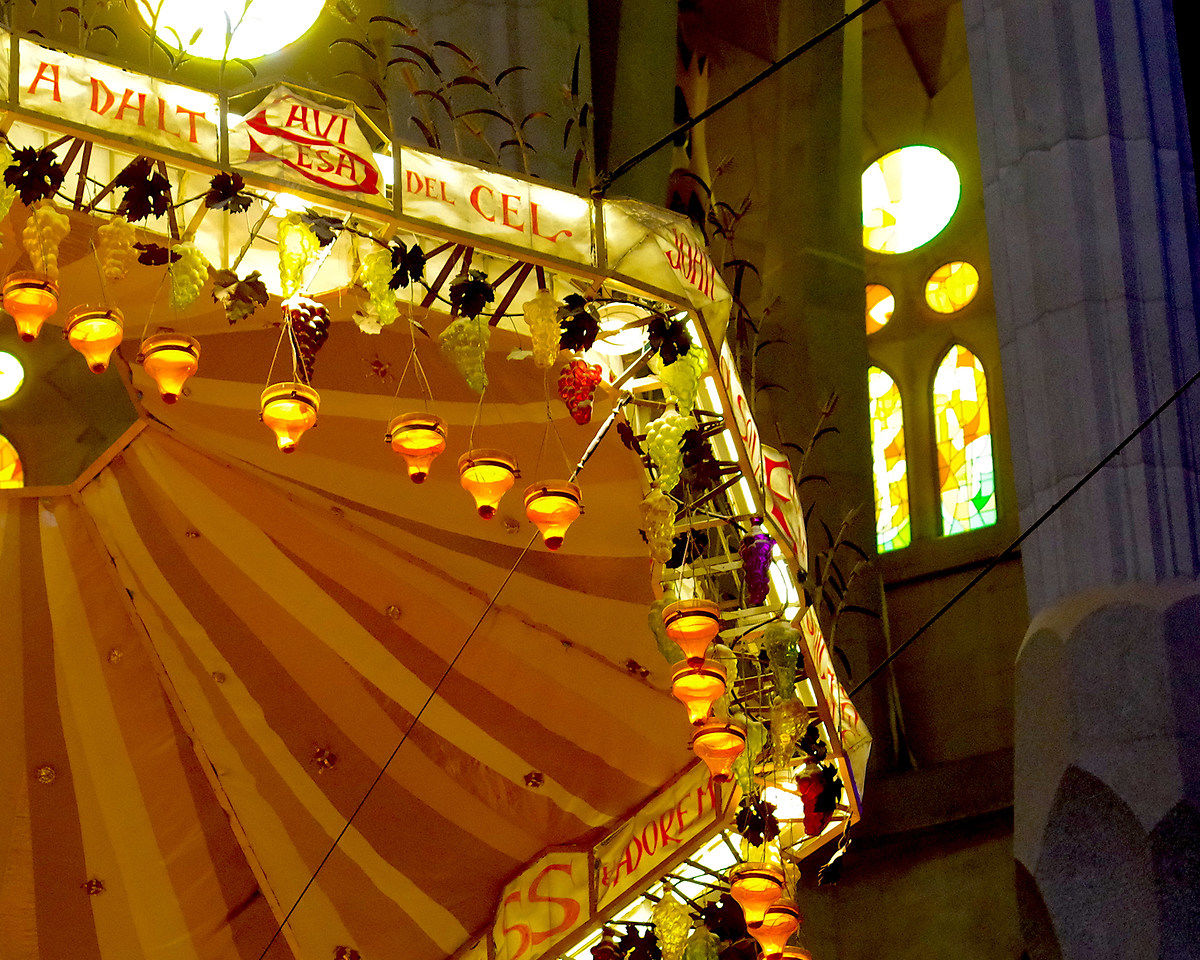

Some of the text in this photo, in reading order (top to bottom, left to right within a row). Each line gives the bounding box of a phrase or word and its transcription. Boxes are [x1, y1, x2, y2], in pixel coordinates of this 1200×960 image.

[27, 62, 206, 143] A DALT
[406, 170, 573, 243] DEL CEL
